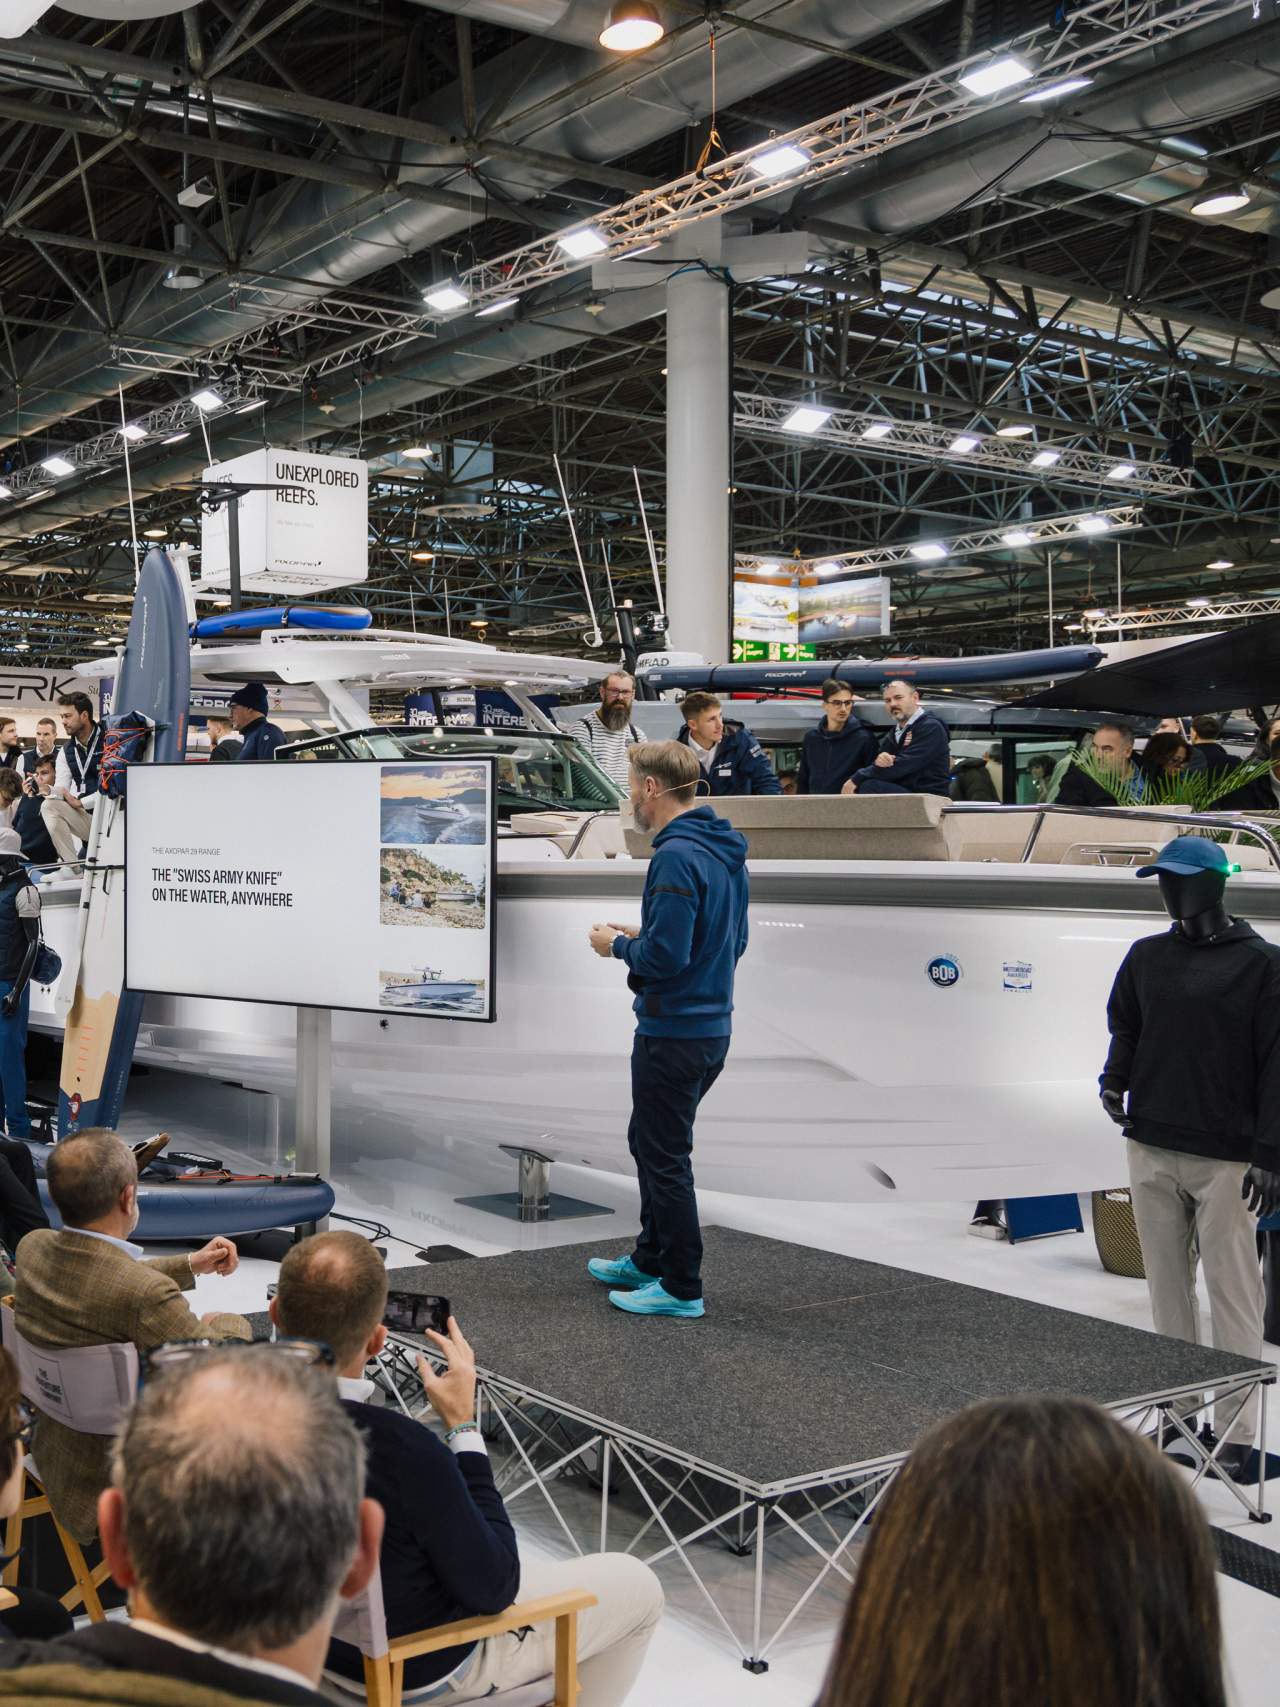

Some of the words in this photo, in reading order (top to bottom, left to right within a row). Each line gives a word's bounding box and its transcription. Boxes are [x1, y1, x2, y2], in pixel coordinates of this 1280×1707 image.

[276, 462, 359, 489] UNEXPLORED
[275, 488, 319, 506] REEFS.
[152, 847, 164, 855] THE
[165, 847, 190, 855] AXOPAR
[198, 848, 221, 856] RANGE
[152, 868, 171, 882] THE
[173, 868, 211, 883] "SWISS
[212, 870, 244, 884] ARMY
[245, 871, 282, 886] KNIFE"
[152, 888, 167, 901] ON
[169, 889, 188, 902] THE
[190, 890, 229, 906] WATER,
[231, 891, 293, 907] ANYWHERE
[931, 965, 956, 980] BOB
